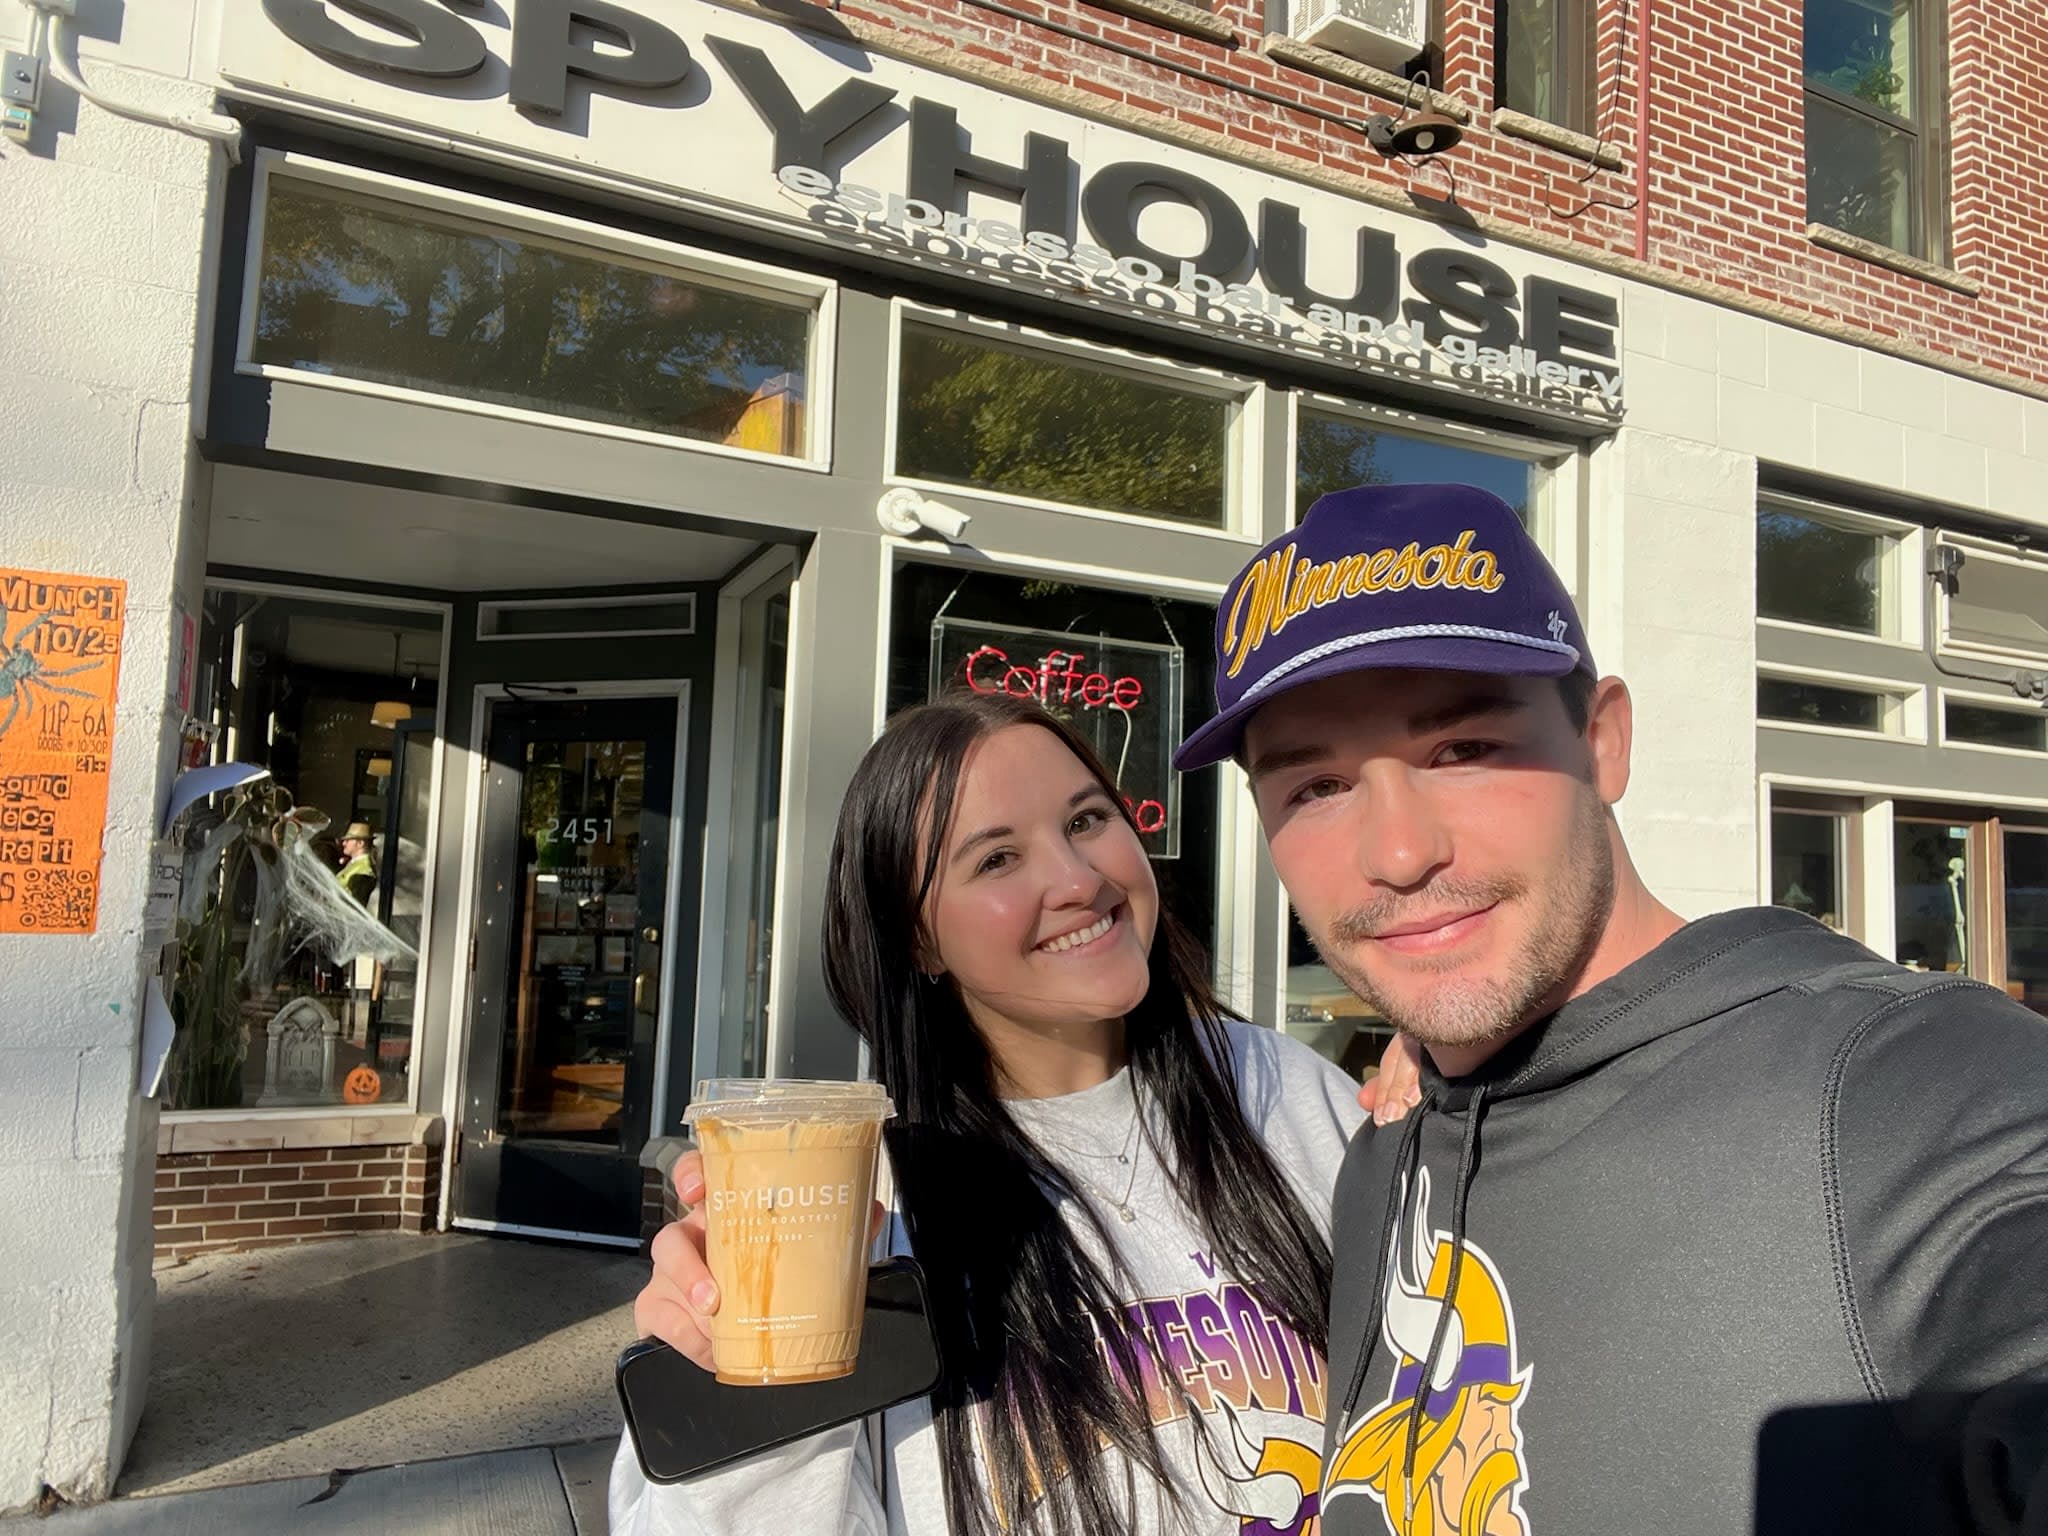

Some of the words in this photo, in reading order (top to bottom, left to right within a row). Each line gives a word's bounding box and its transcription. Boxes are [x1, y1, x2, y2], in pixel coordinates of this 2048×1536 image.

[778, 165, 1163, 283] espresso
[1179, 260, 1294, 316] bar
[1307, 302, 1425, 350] and
[1441, 333, 1624, 397] gallery
[0, 579, 119, 619] MUNCH
[1223, 529, 1505, 678] Minnesota
[35, 623, 119, 656] 10/25
[966, 645, 1143, 709] Coffee
[546, 818, 613, 844] 2451
[712, 1185, 849, 1211] SPYHOUSE
[771, 1214, 838, 1225] ROASTERS
